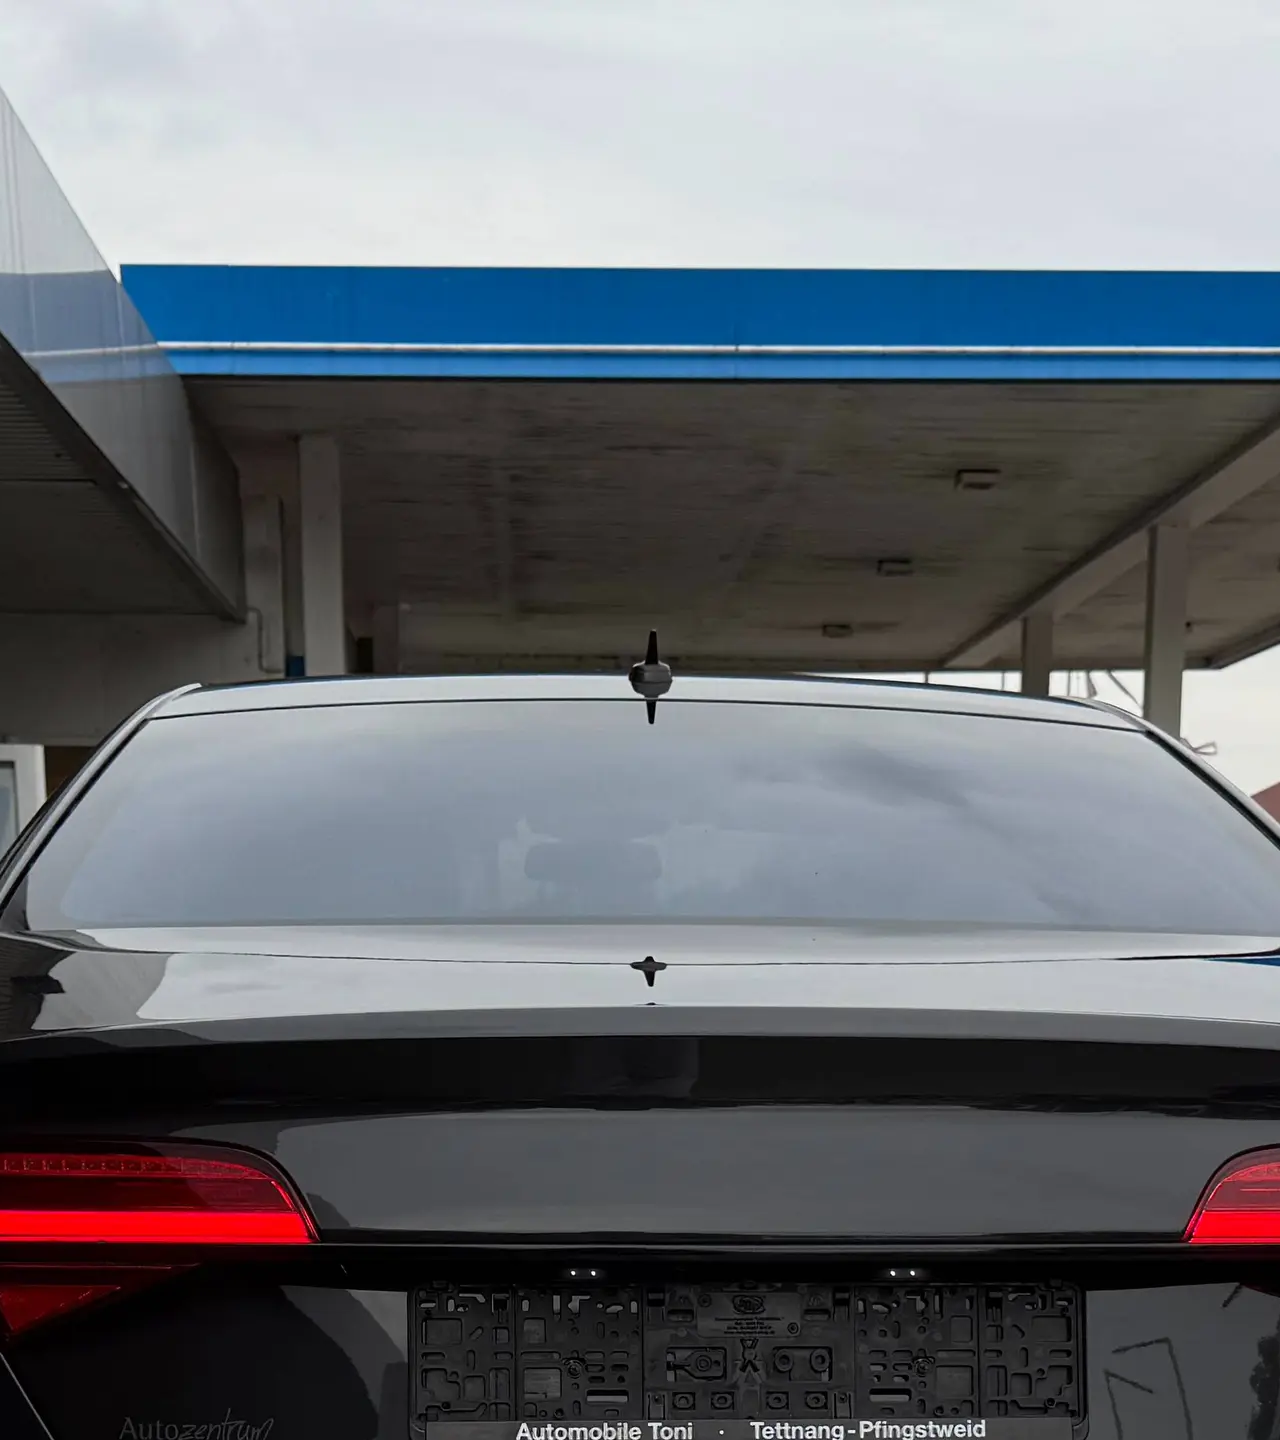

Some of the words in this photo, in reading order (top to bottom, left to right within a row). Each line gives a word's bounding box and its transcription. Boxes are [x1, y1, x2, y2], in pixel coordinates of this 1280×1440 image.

[119, 1408, 275, 1440] Autozentrum
[516, 1422, 642, 1440] Automobile
[648, 1422, 693, 1440] Toni
